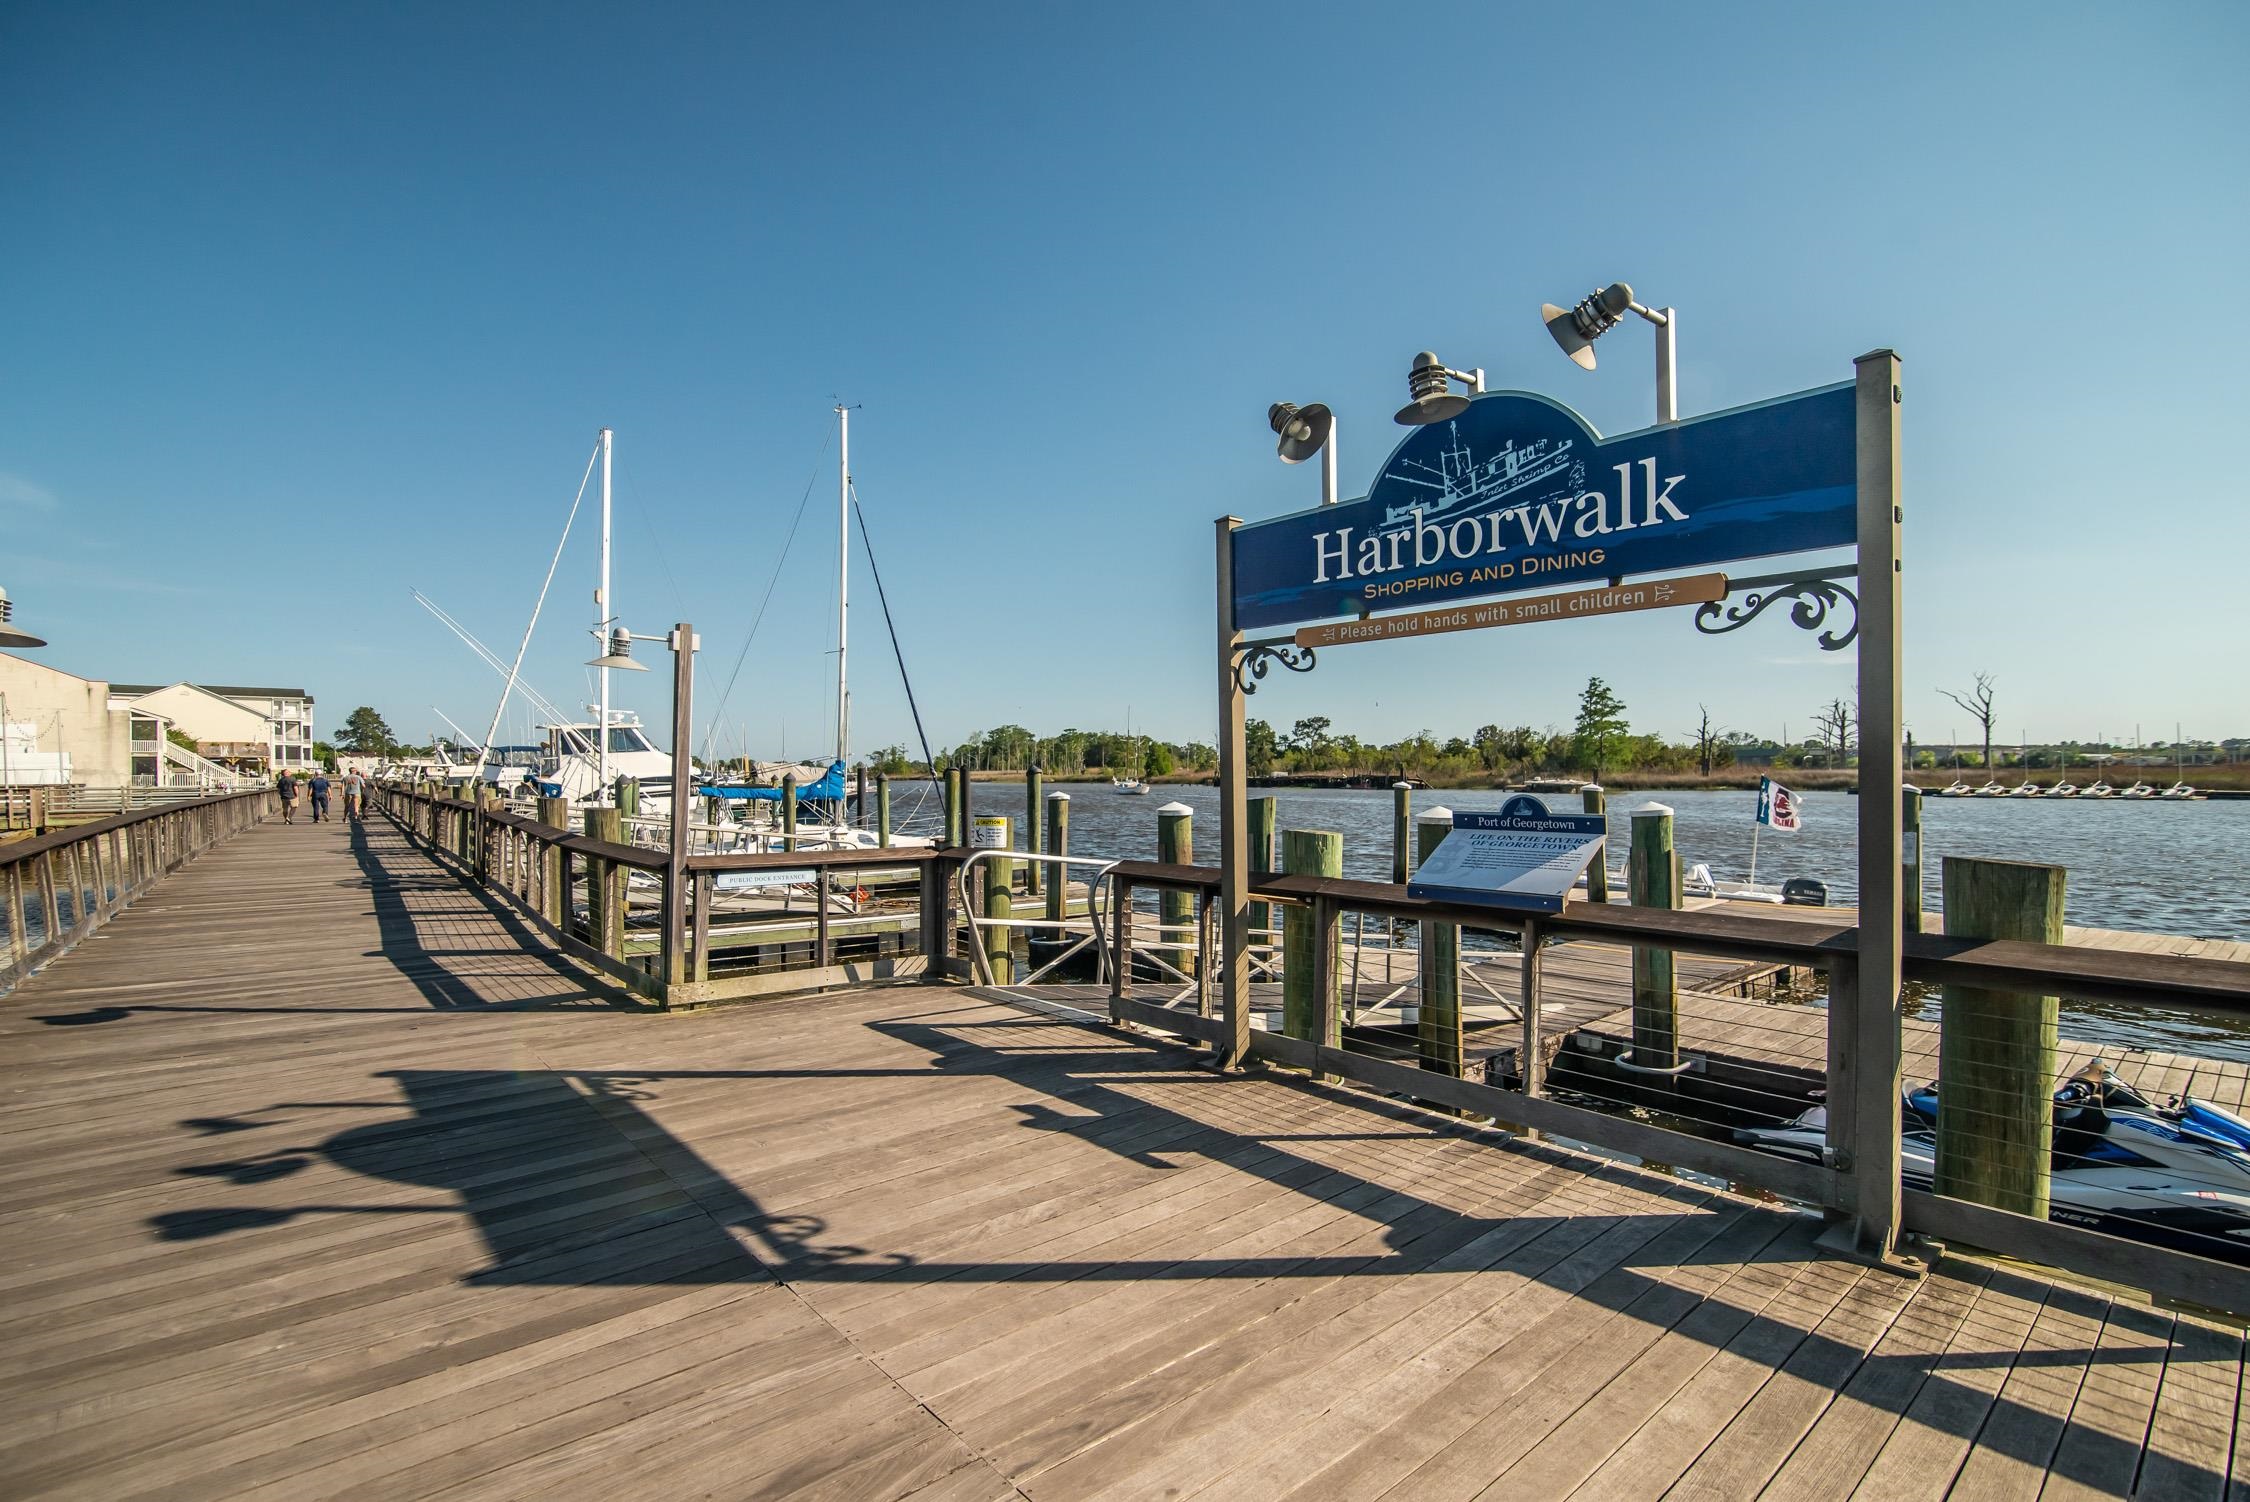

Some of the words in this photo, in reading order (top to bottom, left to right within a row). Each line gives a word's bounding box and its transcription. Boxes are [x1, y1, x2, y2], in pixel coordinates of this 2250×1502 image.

[1511, 463, 1552, 486] Shrimp
[1312, 456, 1690, 584] Harborwalk
[1364, 571, 1464, 599] SHOPPING
[1470, 564, 1515, 582] AND
[1522, 549, 1606, 575] DINING
[1340, 624, 1382, 640] Please
[1388, 618, 1418, 633] hold
[1424, 612, 1468, 629] hands
[1474, 605, 1508, 624] with
[1515, 598, 1562, 618] small
[1569, 589, 1645, 613] children
[1478, 816, 1498, 826] Port
[1500, 817, 1511, 827] of
[1512, 817, 1575, 830] Georgetown
[1489, 841, 1579, 850] GEORGETOWN
[1543, 836, 1590, 844] RIVERS
